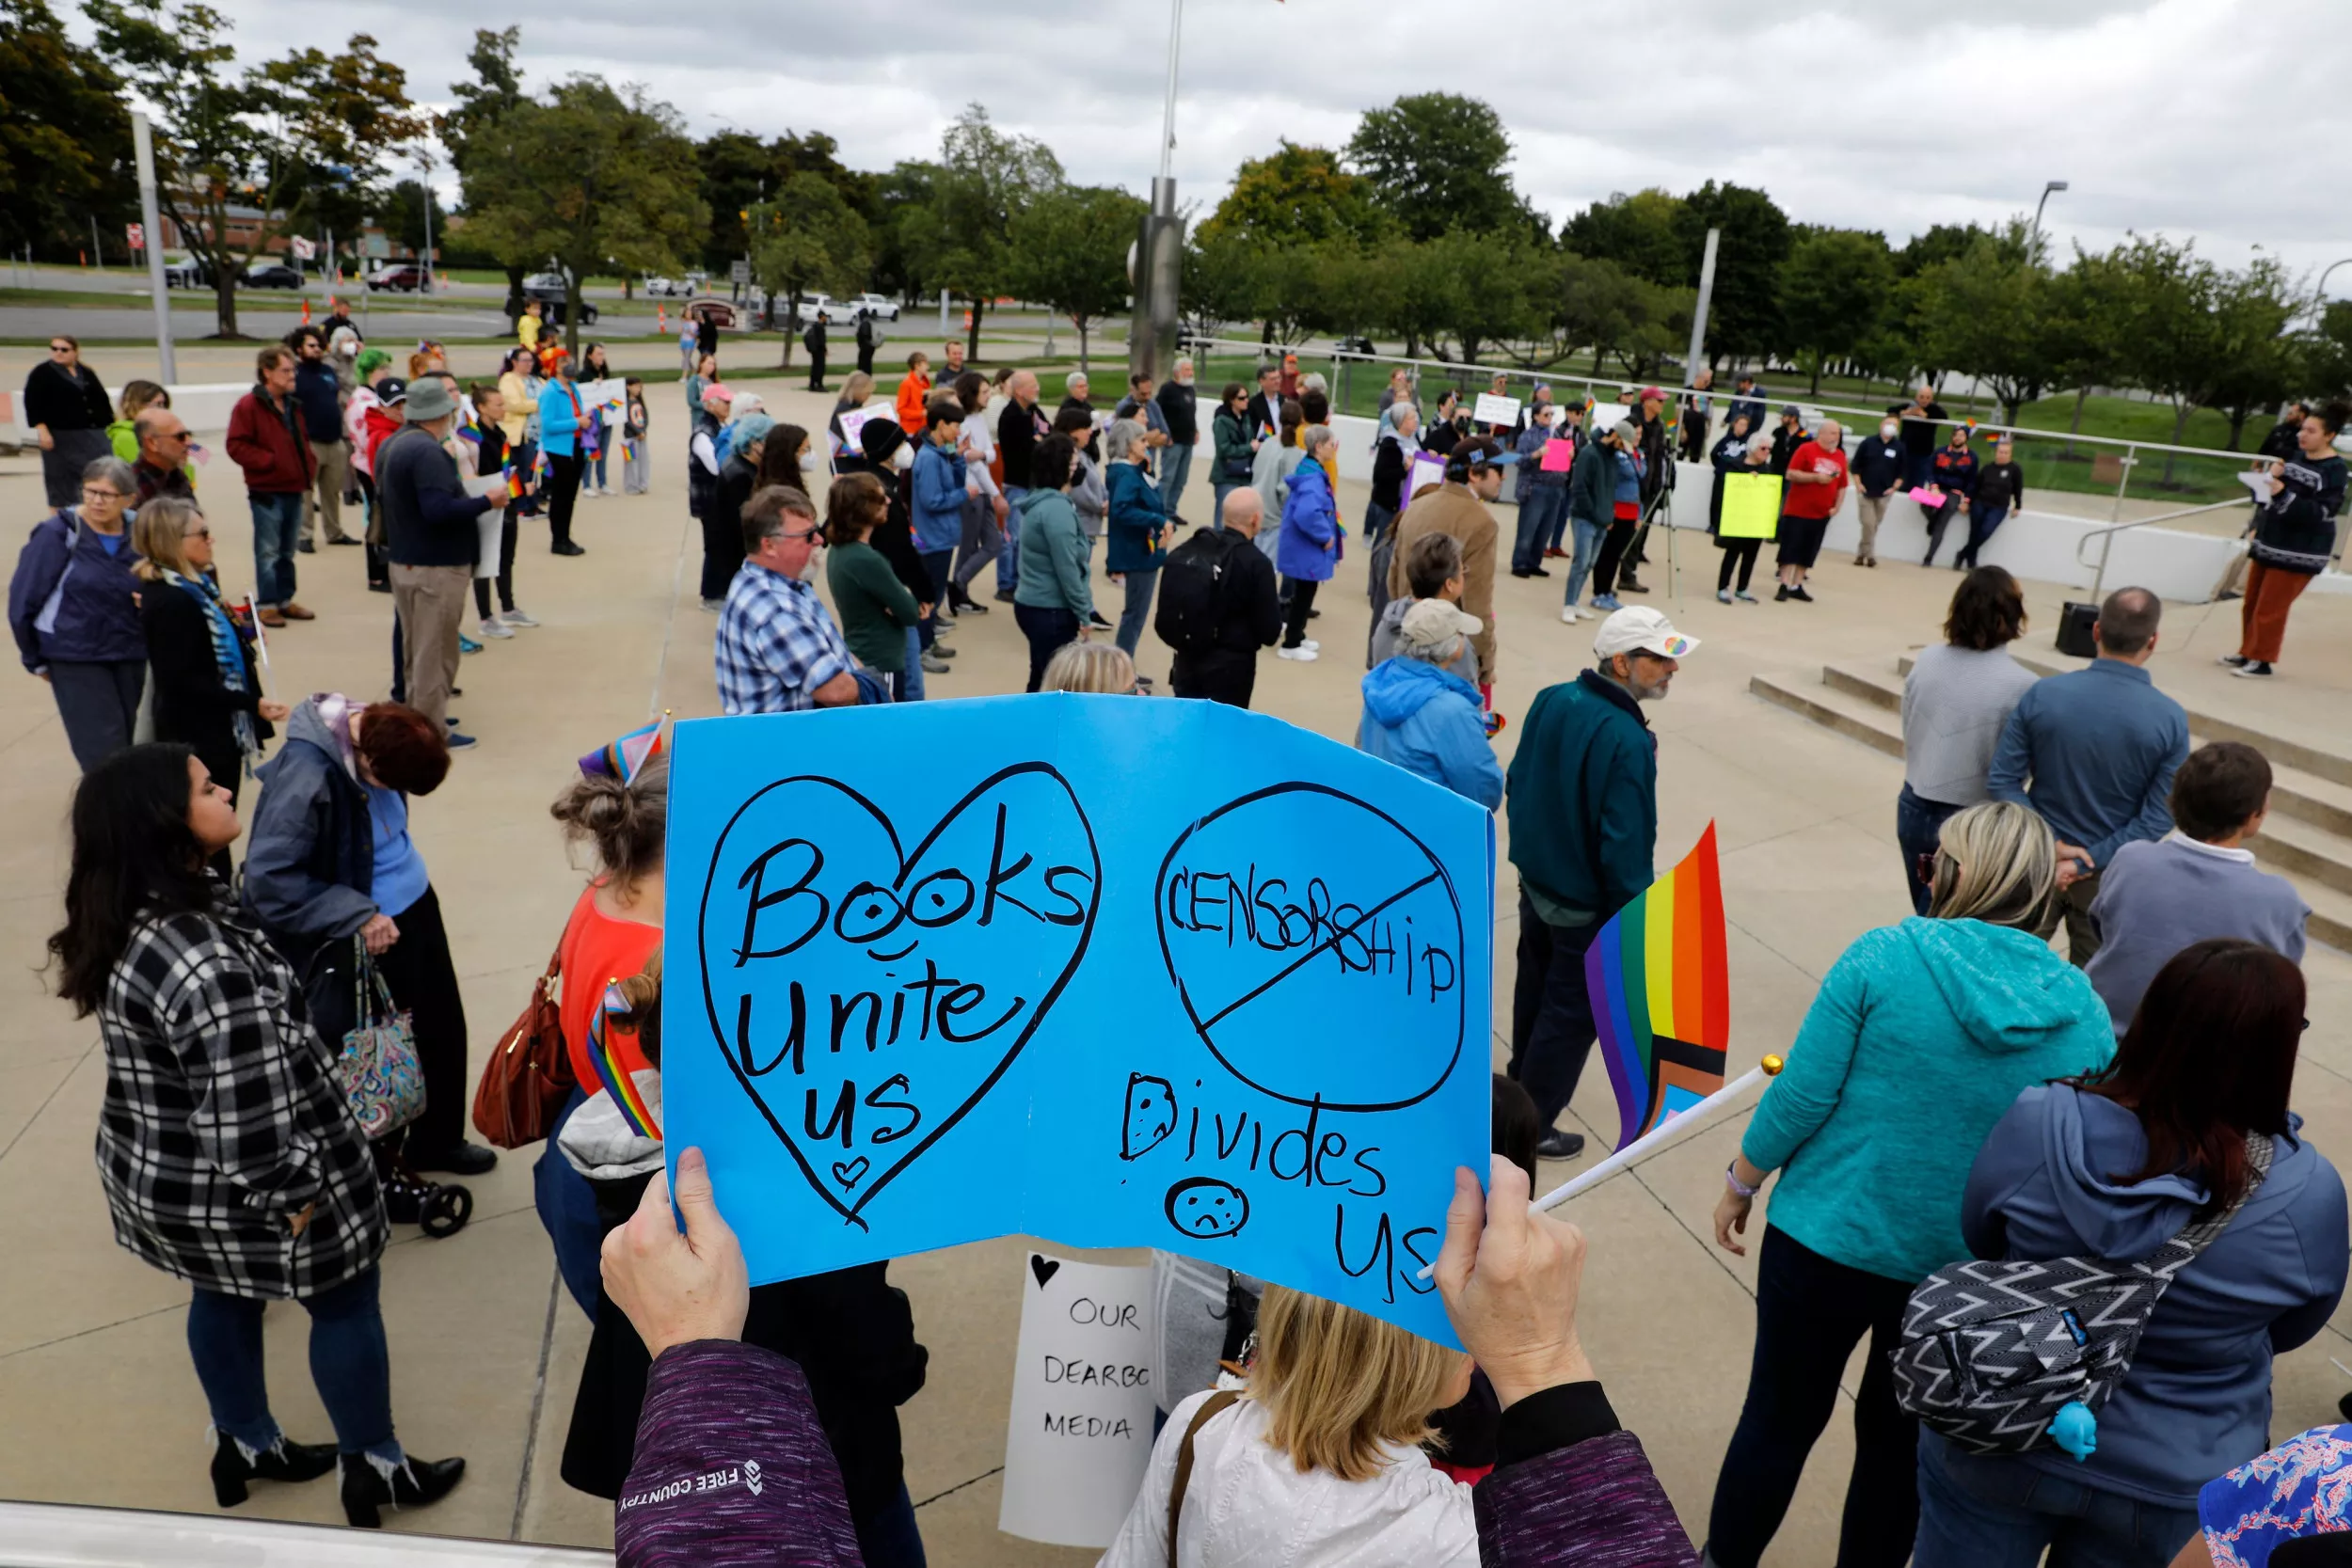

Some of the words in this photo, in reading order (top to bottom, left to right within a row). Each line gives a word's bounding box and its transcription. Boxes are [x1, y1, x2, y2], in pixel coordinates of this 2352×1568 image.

[734, 802, 1092, 967] Books
[1120, 1071, 1386, 1196] Divides
[1070, 1297, 1141, 1331] OUR
[1044, 1412, 1133, 1440] MEDIA
[696, 1467, 739, 1492] FREE
